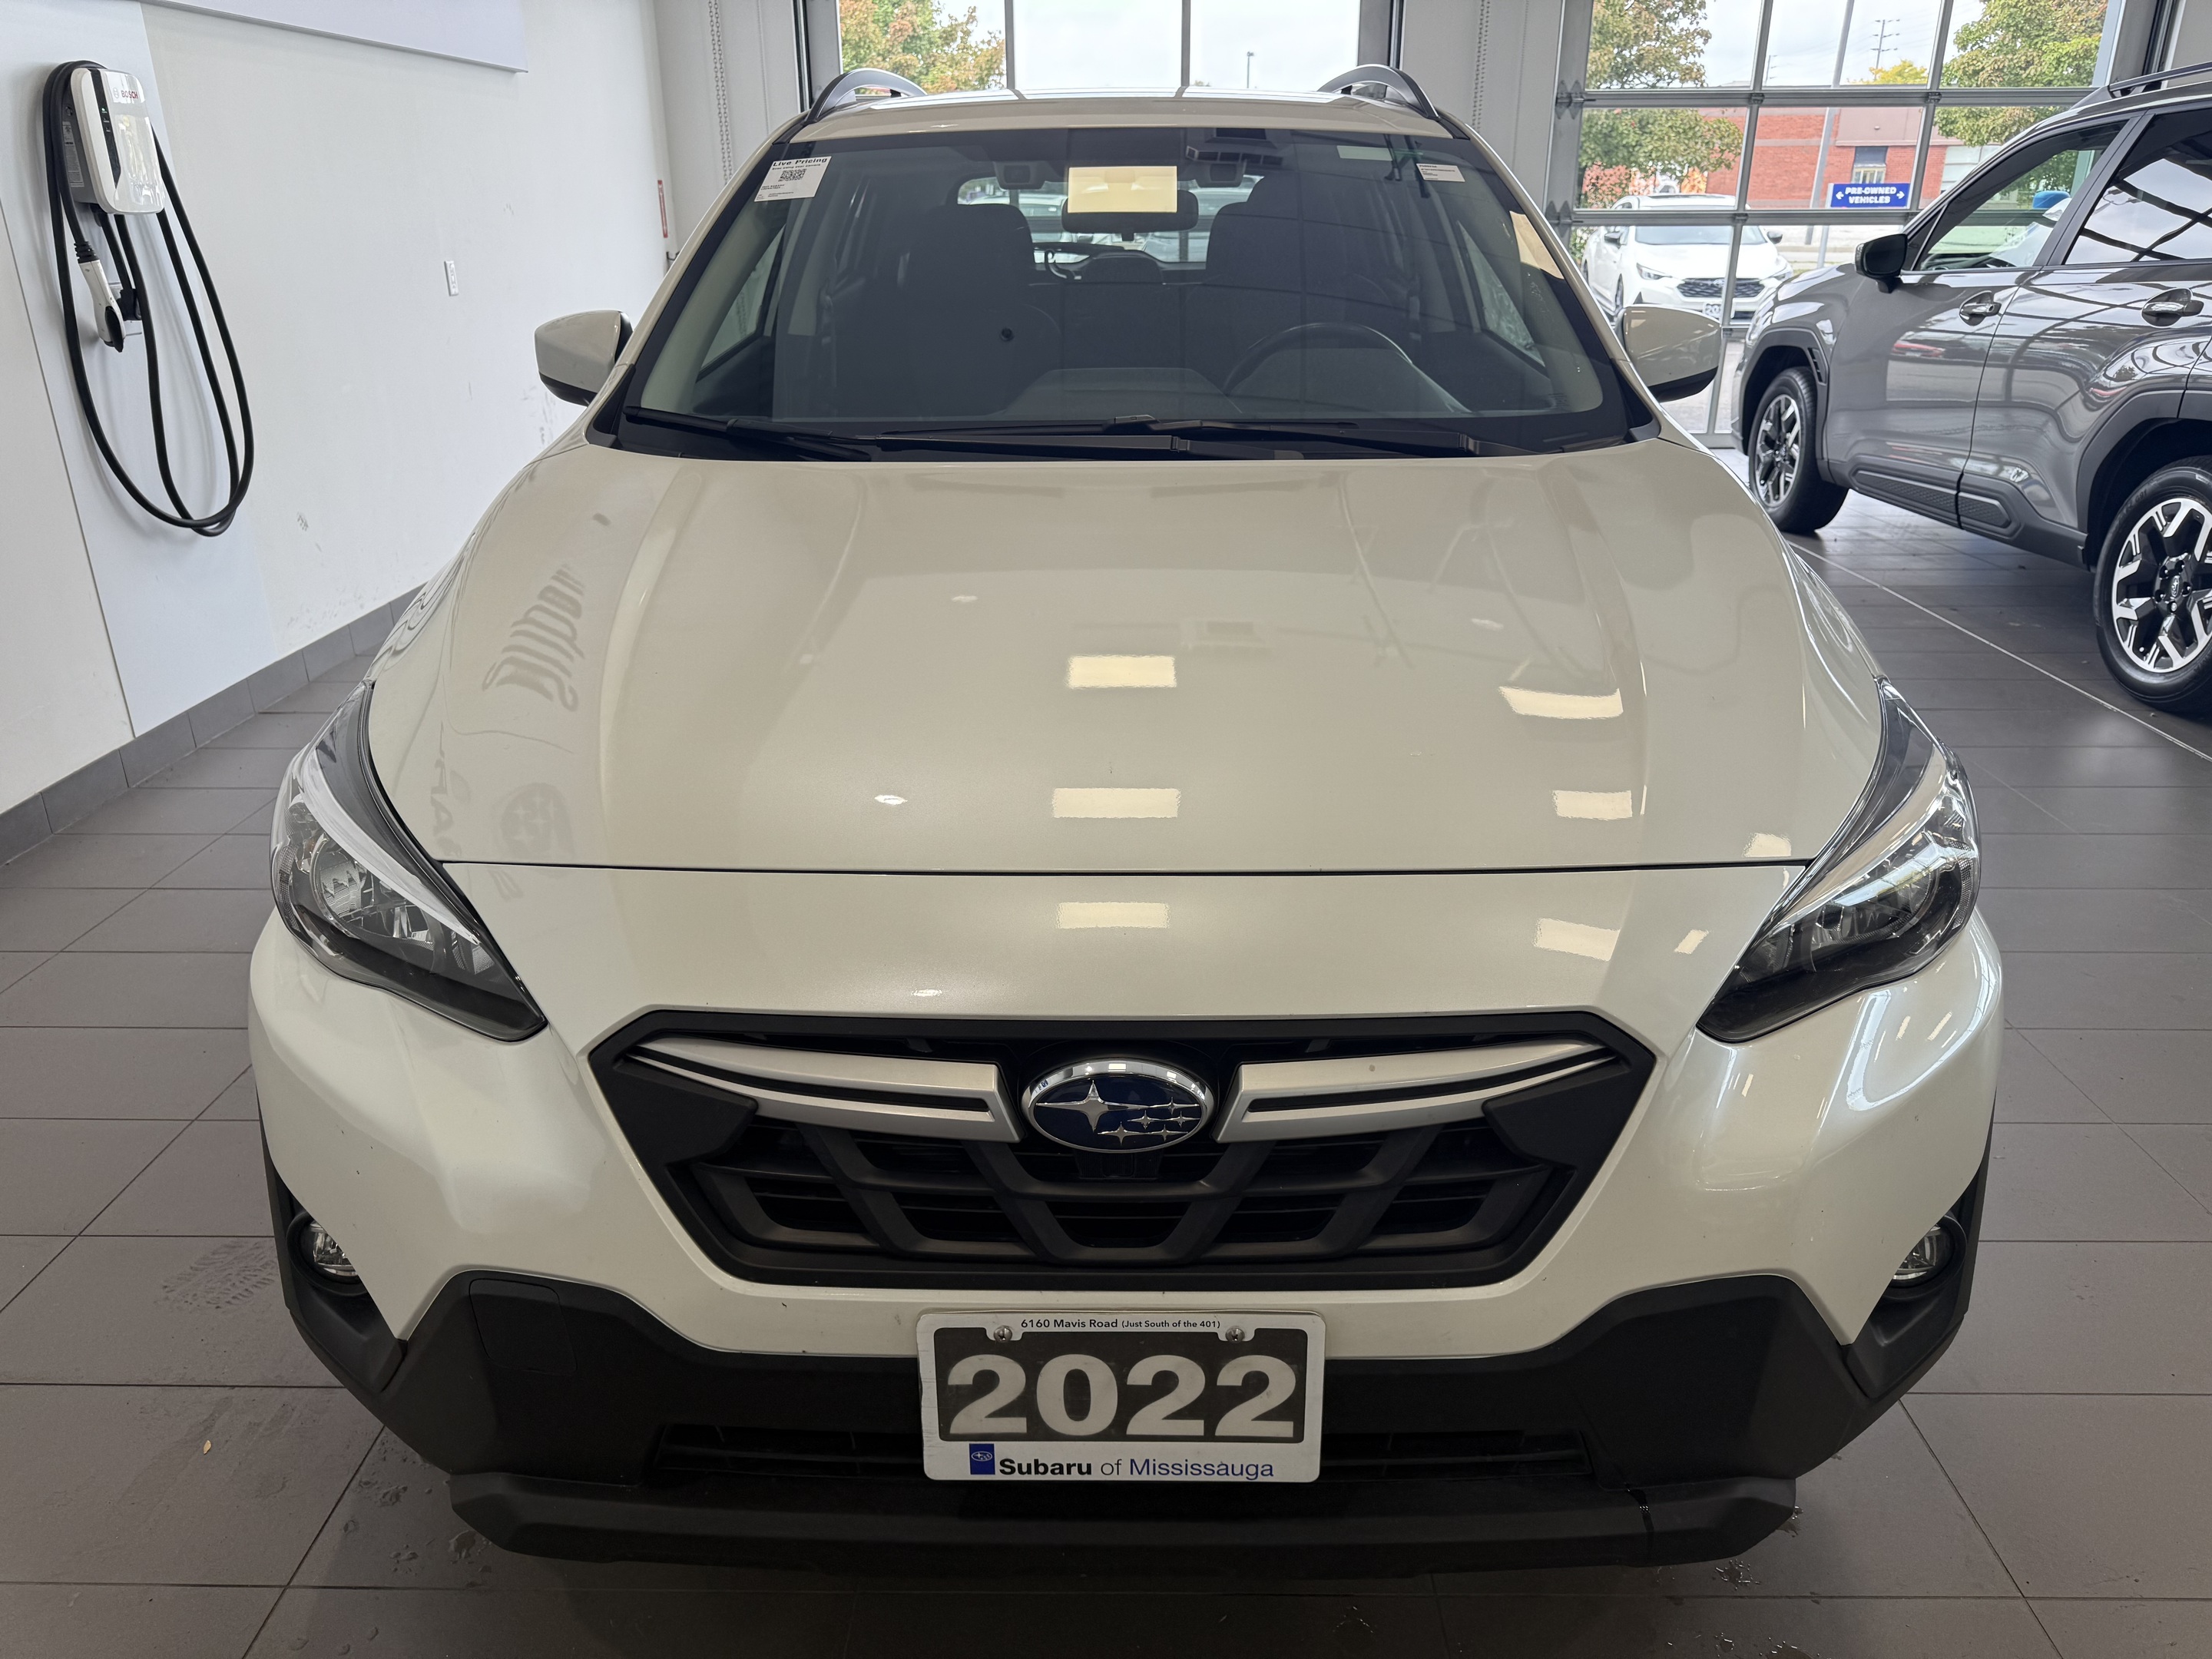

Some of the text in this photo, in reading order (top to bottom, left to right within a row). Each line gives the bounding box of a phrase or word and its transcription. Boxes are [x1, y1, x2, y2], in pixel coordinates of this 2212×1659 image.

[121, 90, 138, 99] BOSCH
[1845, 187, 1897, 195] PRE-OWNED
[1021, 1318, 1220, 1329] 6160 Mavis Road (Just South of the 401)
[947, 1353, 1296, 1438] 2022
[998, 1458, 1274, 1481] Subaru of Mississauga
